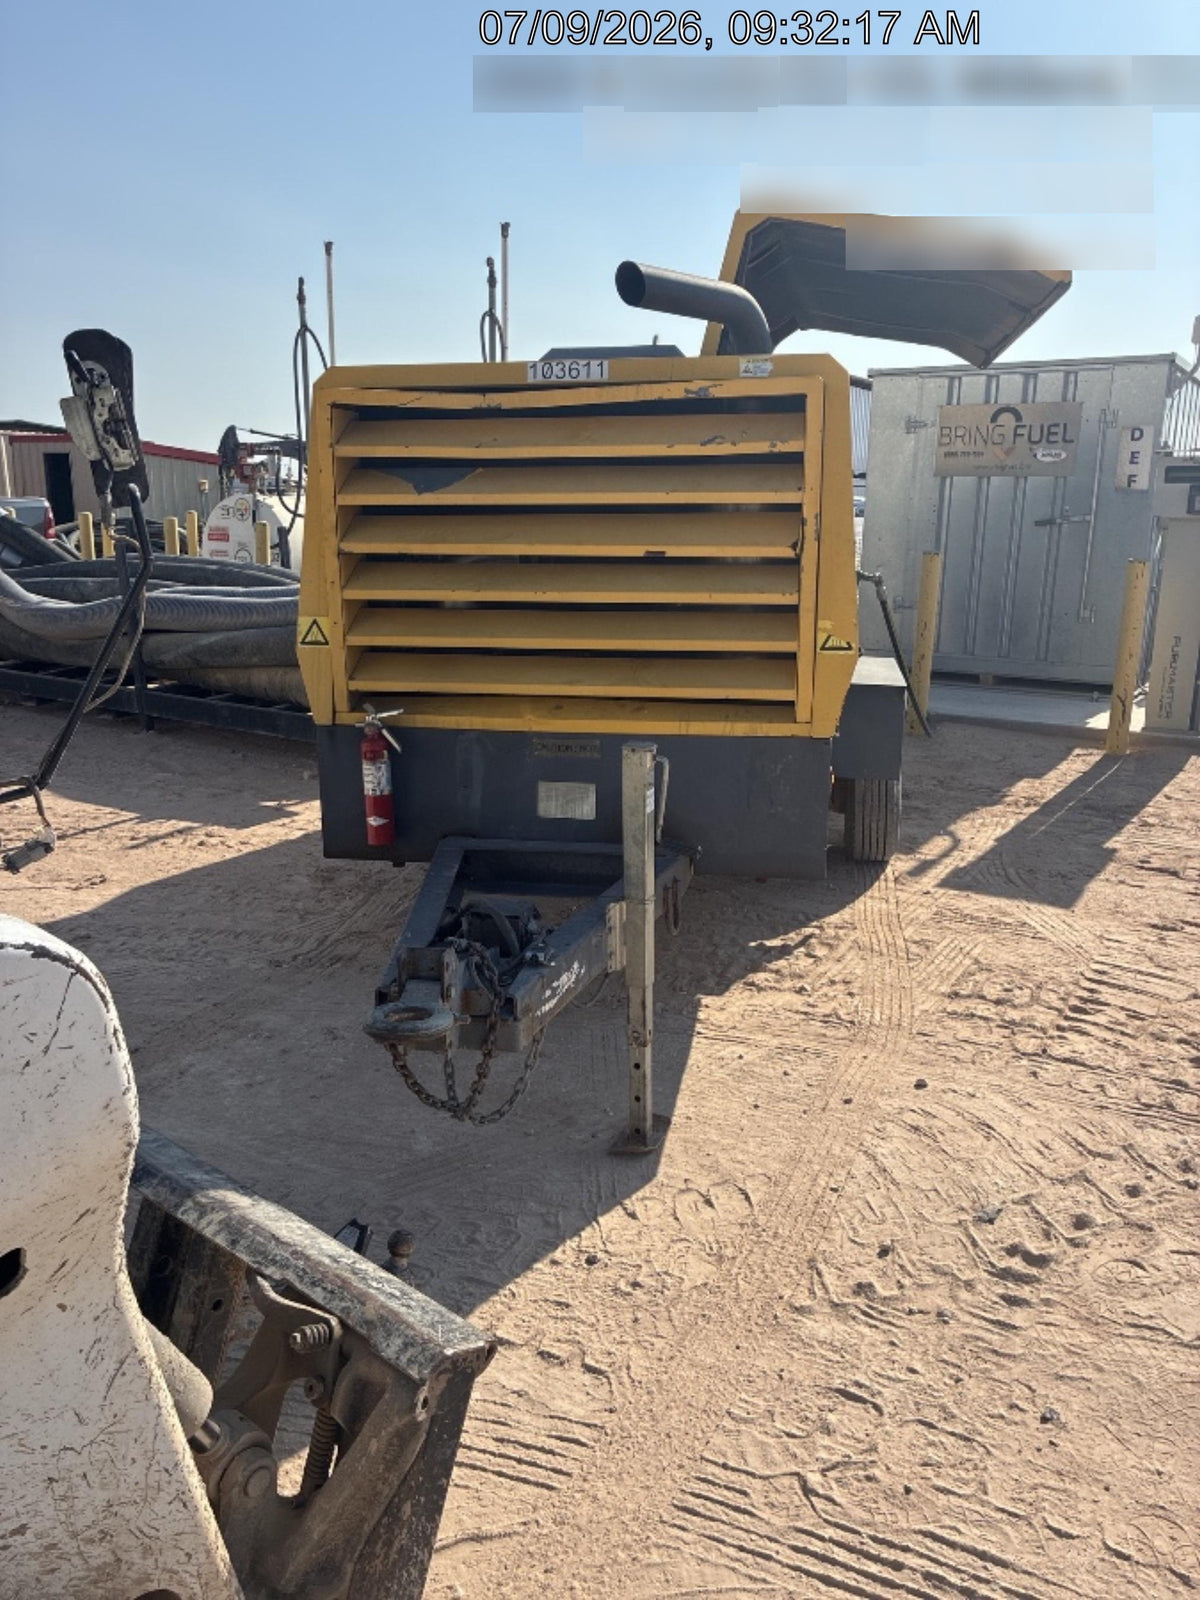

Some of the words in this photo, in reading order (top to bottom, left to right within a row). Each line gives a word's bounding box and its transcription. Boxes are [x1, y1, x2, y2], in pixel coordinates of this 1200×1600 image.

[528, 360, 605, 380] 103611
[938, 424, 1006, 448] BRING
[1012, 422, 1075, 445] FUEL
